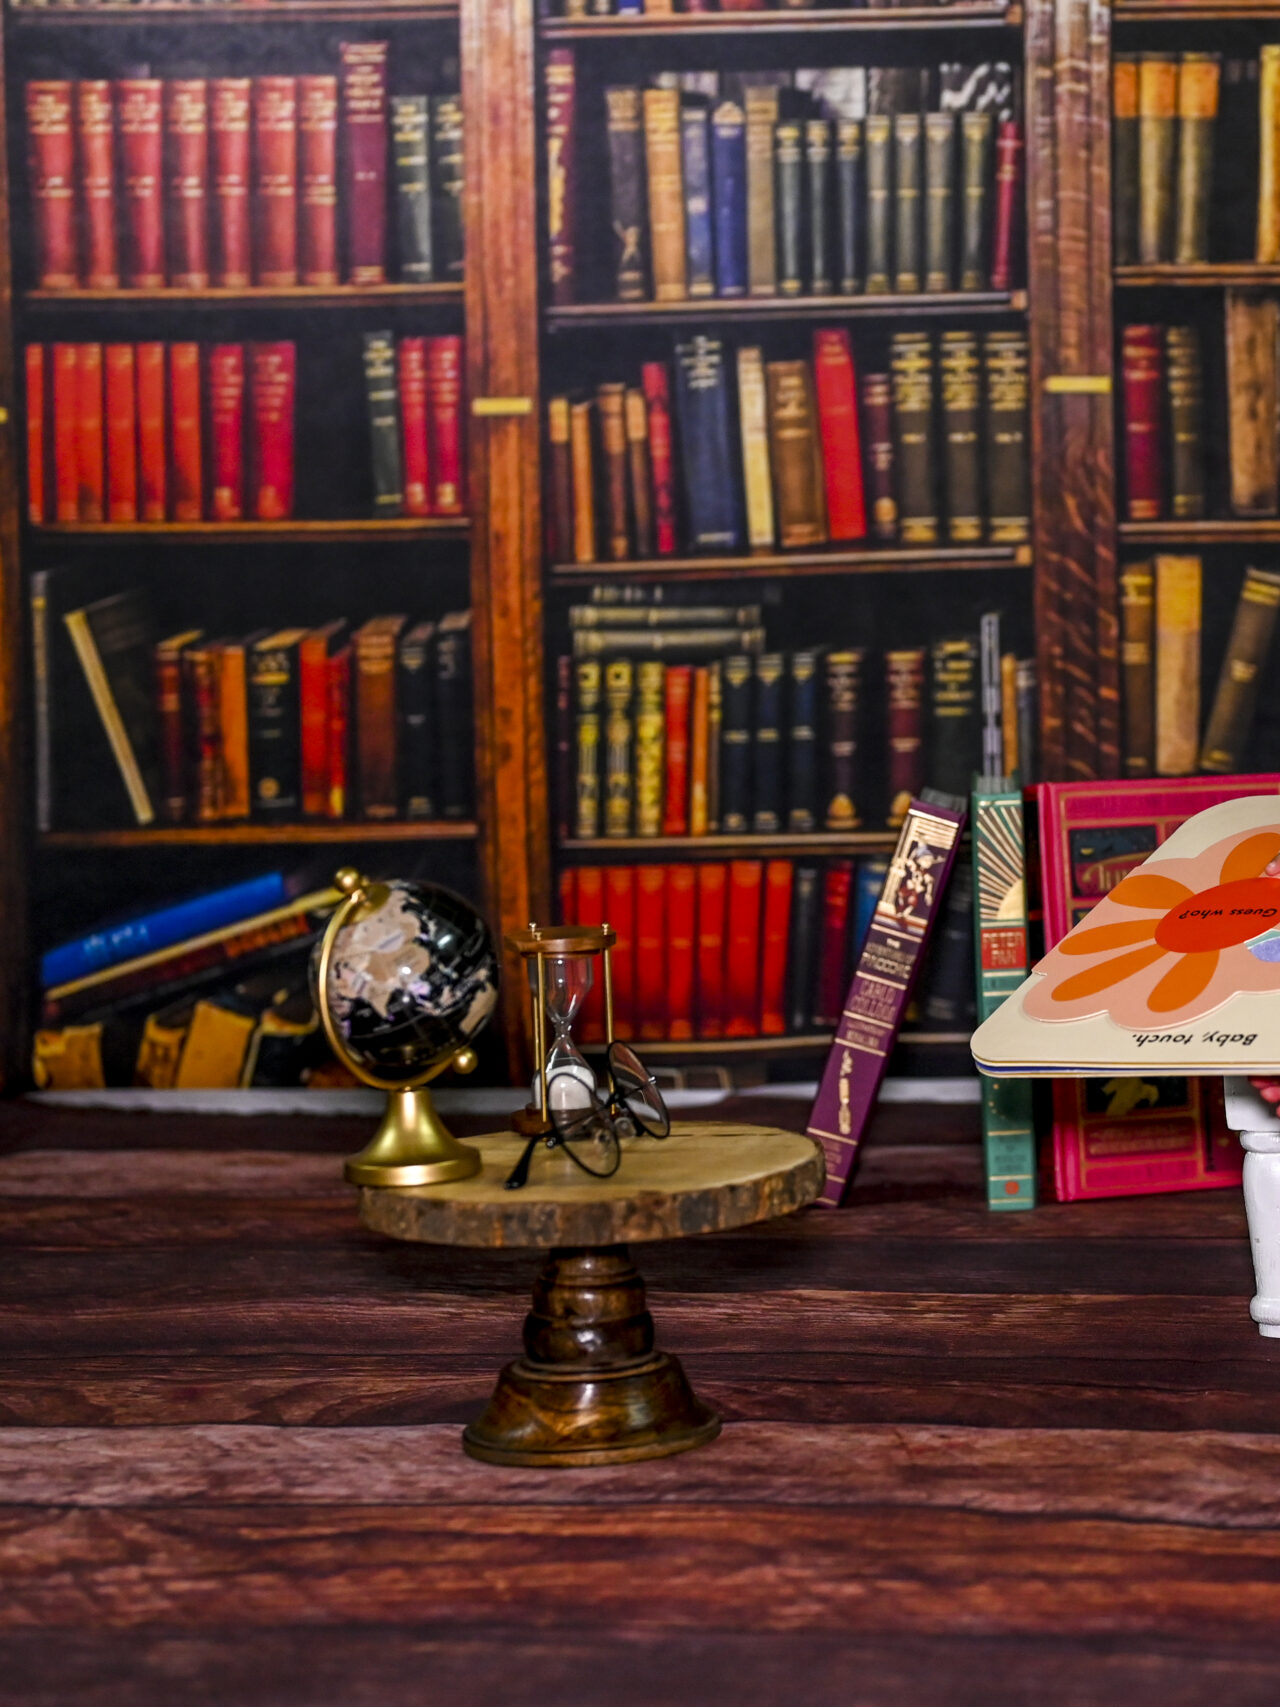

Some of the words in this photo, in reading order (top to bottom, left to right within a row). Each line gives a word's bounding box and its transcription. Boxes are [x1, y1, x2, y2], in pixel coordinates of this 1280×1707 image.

[1178, 908, 1224, 920] who?
[1229, 907, 1279, 918] Guess
[982, 930, 1025, 950] PETER
[991, 949, 1018, 968] PAN
[1131, 1033, 1194, 1048] touch.
[1202, 1030, 1259, 1048] Baby,
